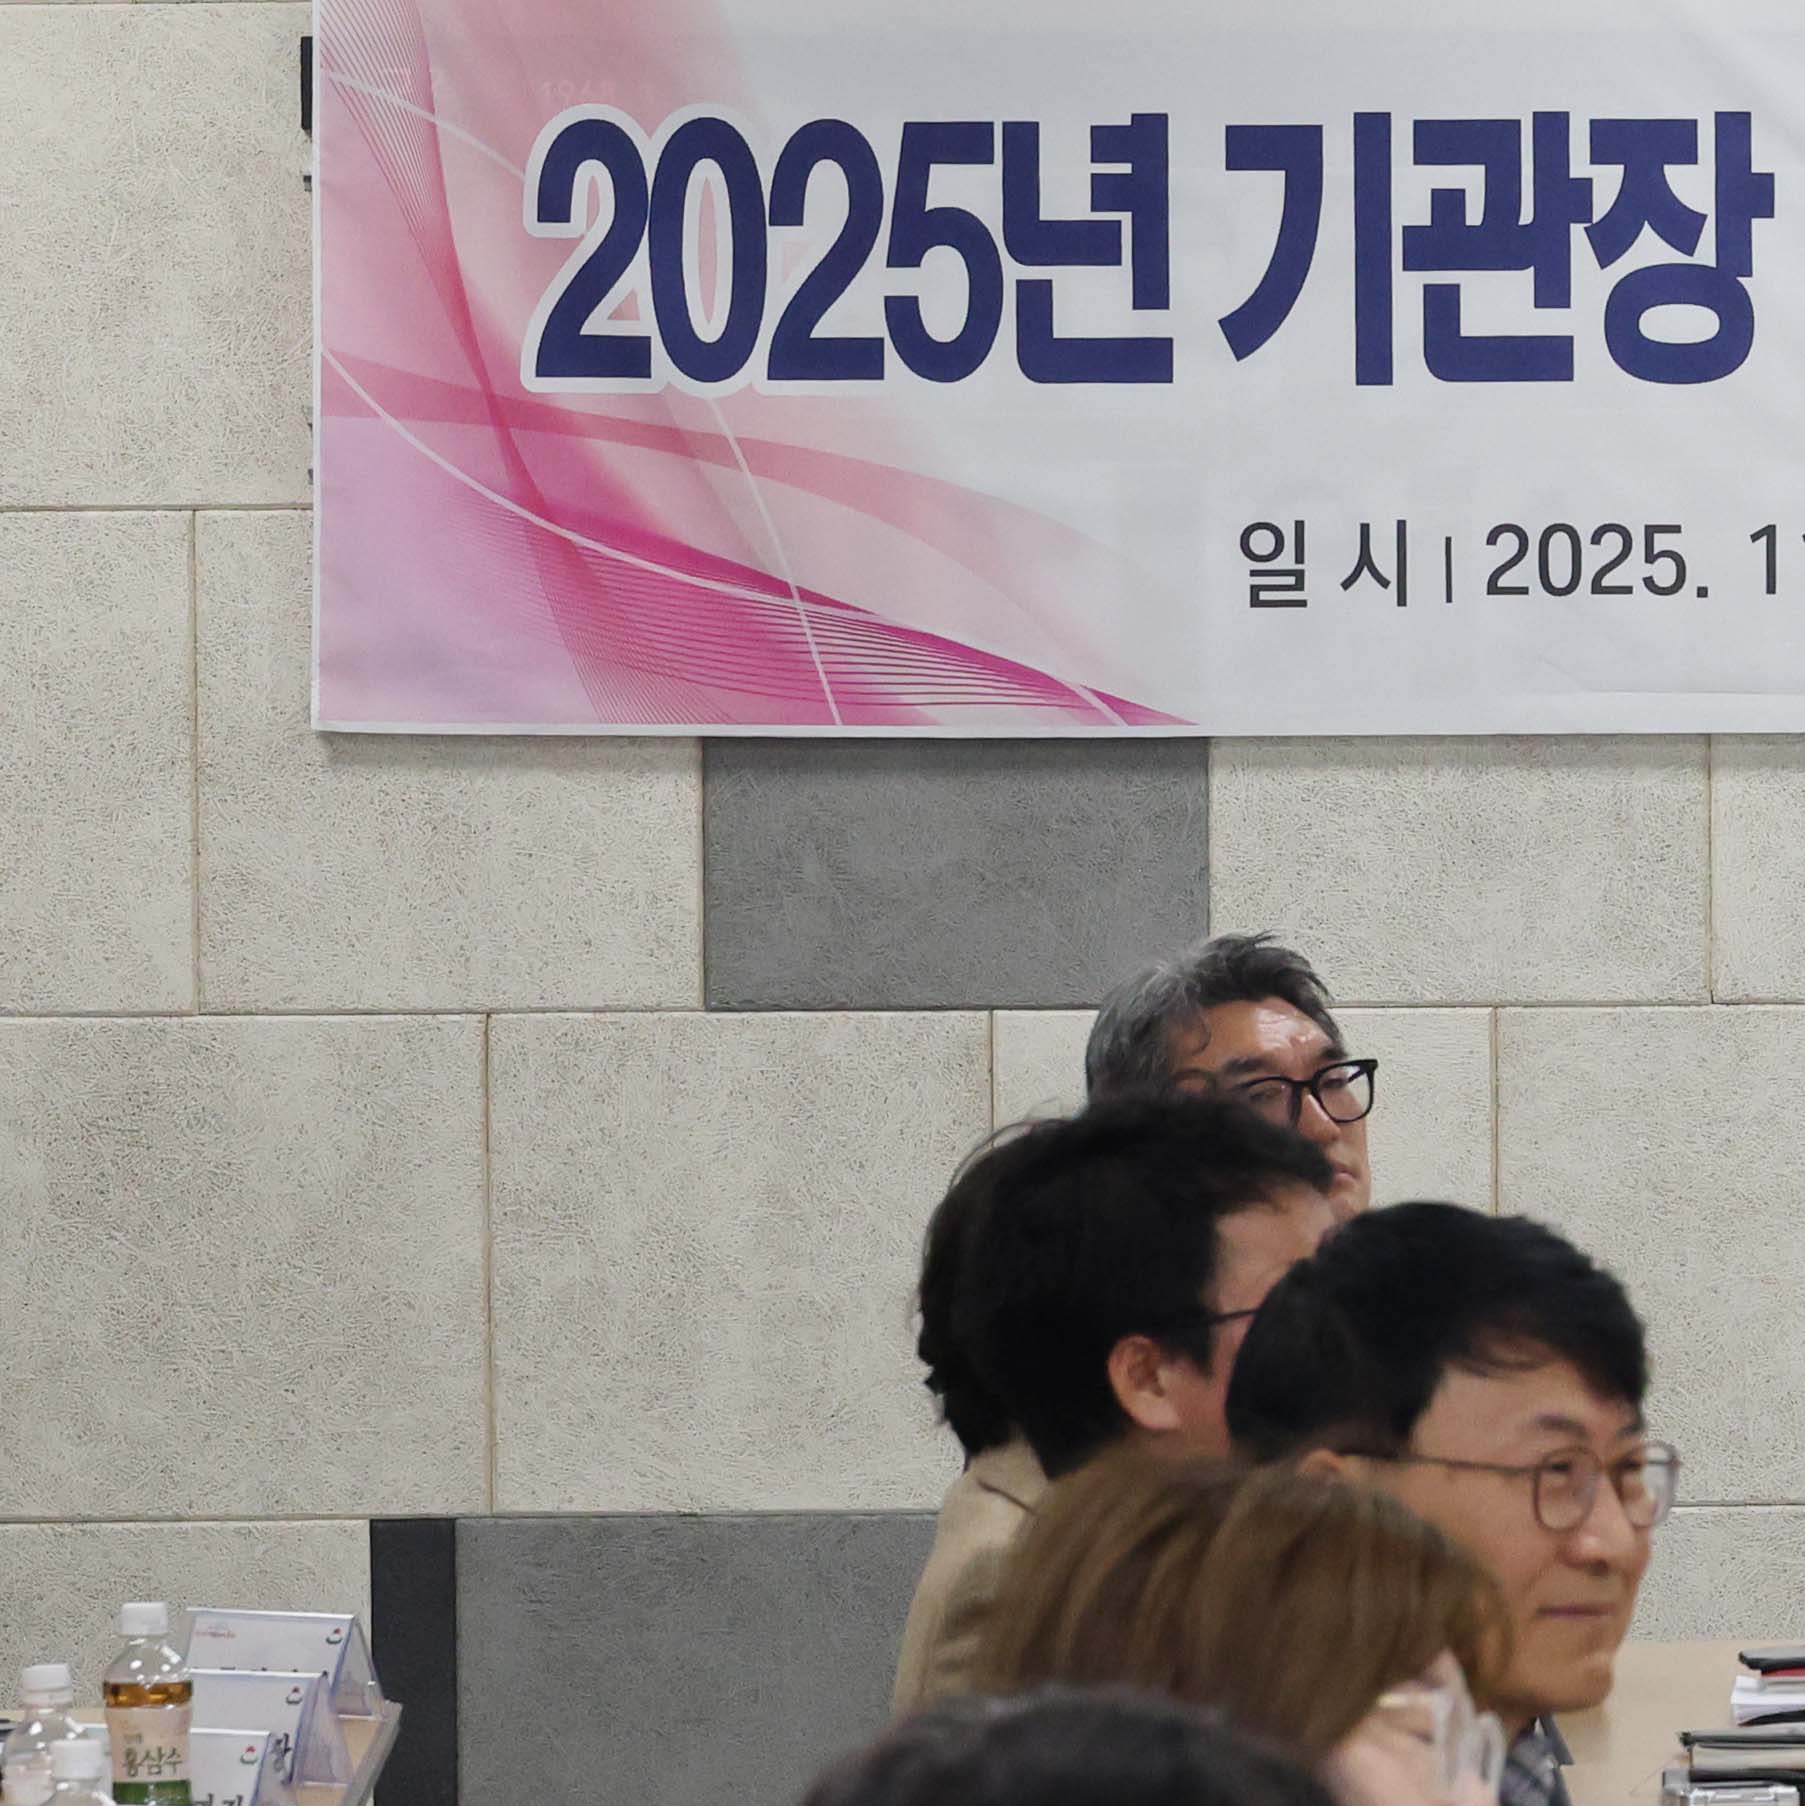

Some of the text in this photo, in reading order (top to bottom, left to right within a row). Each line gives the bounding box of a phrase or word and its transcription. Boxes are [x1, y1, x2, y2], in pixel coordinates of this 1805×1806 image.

[536, 113, 1174, 384] 2025년
[1218, 112, 1775, 386] 기관장
[1485, 522, 1710, 599] 2025.
[122, 1746, 183, 1777] 홍삼수
